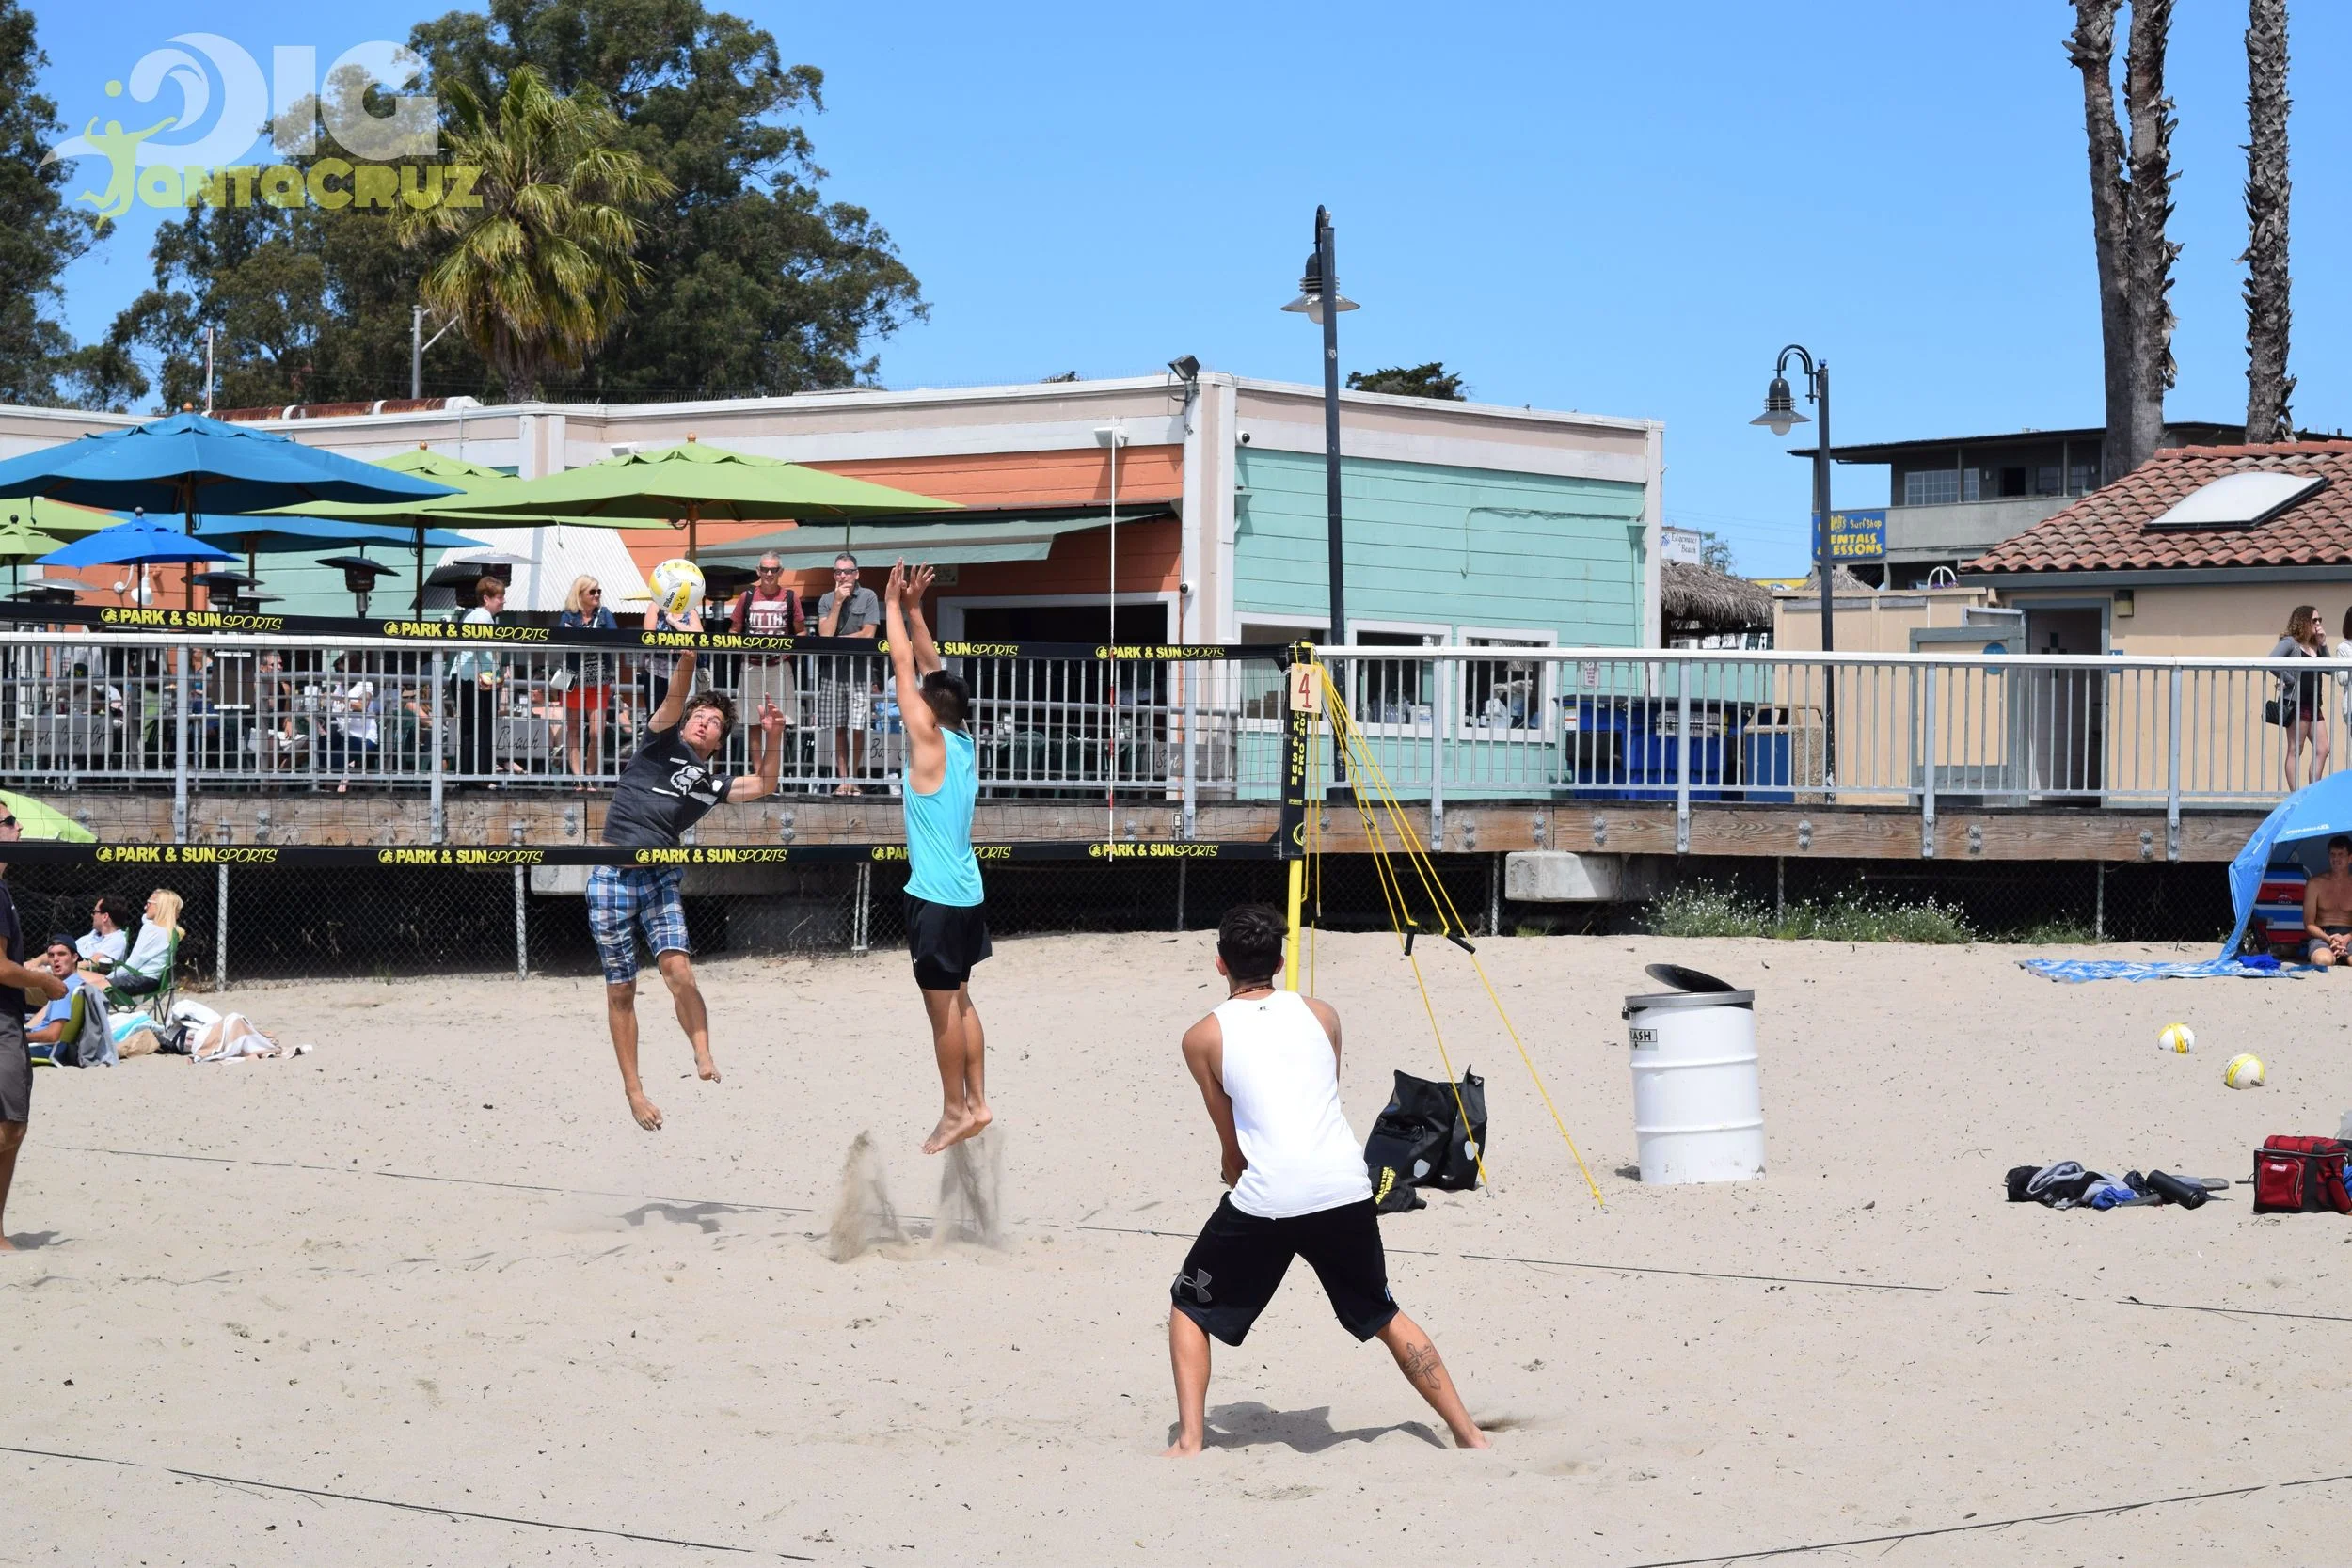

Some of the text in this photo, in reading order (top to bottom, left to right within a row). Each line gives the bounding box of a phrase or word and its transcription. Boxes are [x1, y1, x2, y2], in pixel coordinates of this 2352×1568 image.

[1830, 533, 1877, 544] ENTALS
[1833, 544, 1883, 555] ESSONS
[120, 609, 166, 625] PARK
[170, 611, 183, 626] &
[402, 622, 443, 637] PARK
[447, 624, 458, 638] &
[659, 633, 695, 646] PARK
[699, 634, 709, 647] &
[1145, 646, 1154, 658] &
[1298, 673, 1312, 708] 4
[115, 847, 161, 862] PARK
[165, 847, 177, 863] &
[396, 849, 437, 863] PARK
[440, 850, 453, 863] &
[652, 848, 690, 863] PARK
[692, 849, 704, 863] &
[887, 846, 1012, 860] PAR PORTS
[1137, 844, 1147, 856] &
